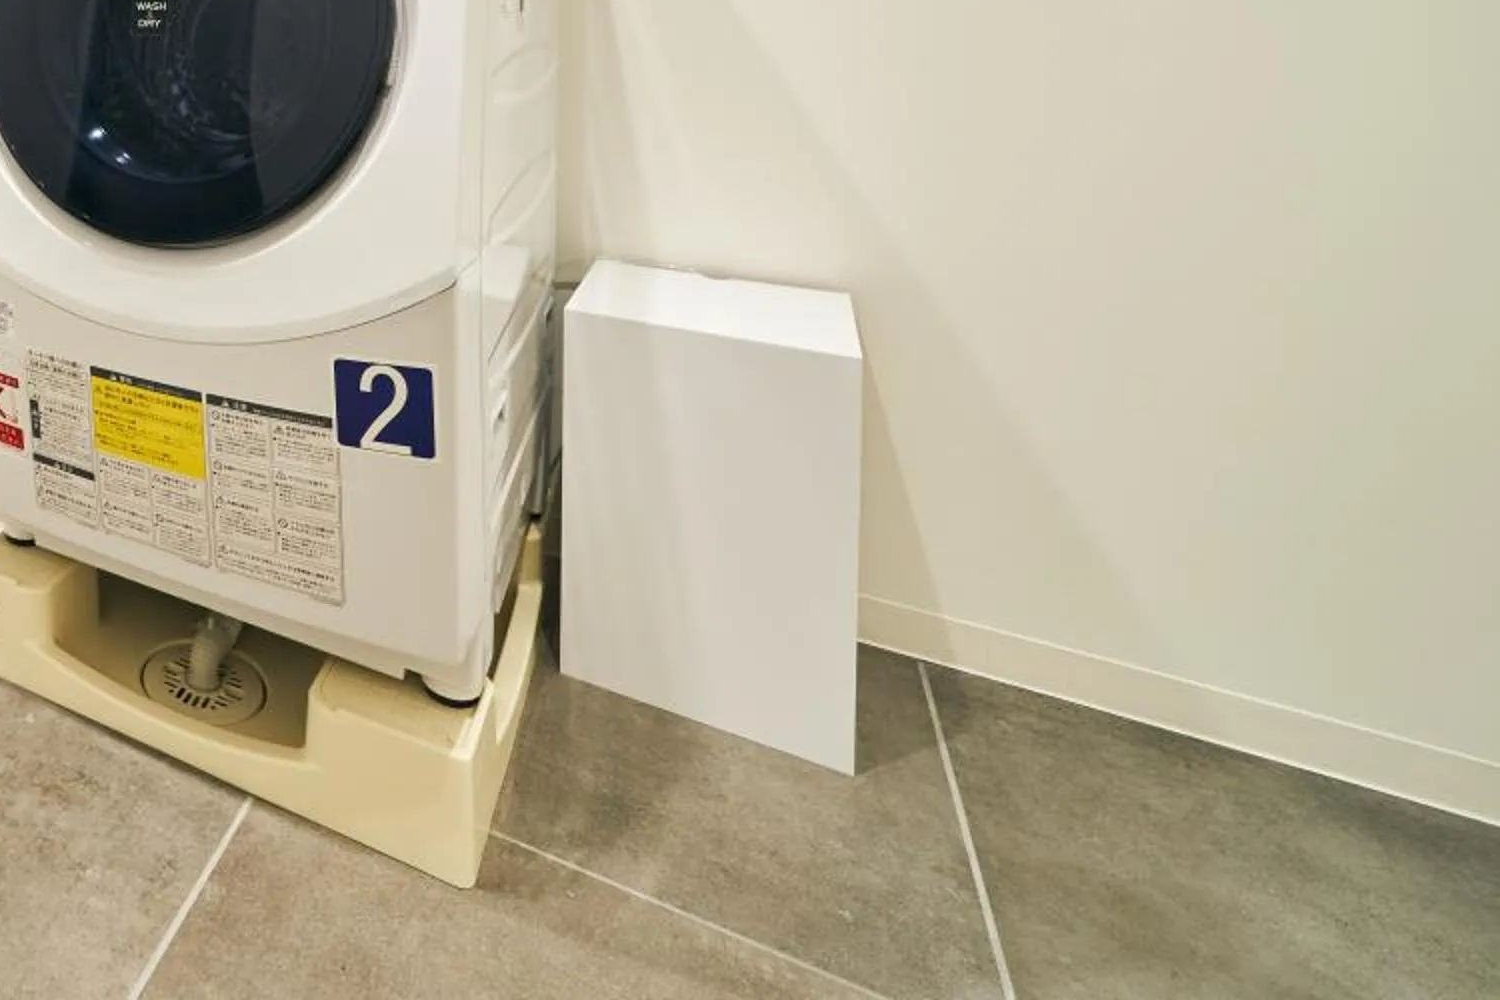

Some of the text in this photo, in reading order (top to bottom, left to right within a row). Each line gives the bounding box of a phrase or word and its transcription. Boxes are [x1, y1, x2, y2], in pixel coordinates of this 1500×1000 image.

[135, 1, 167, 11] WASH
[137, 19, 161, 28] DRY
[359, 365, 413, 456] 2
